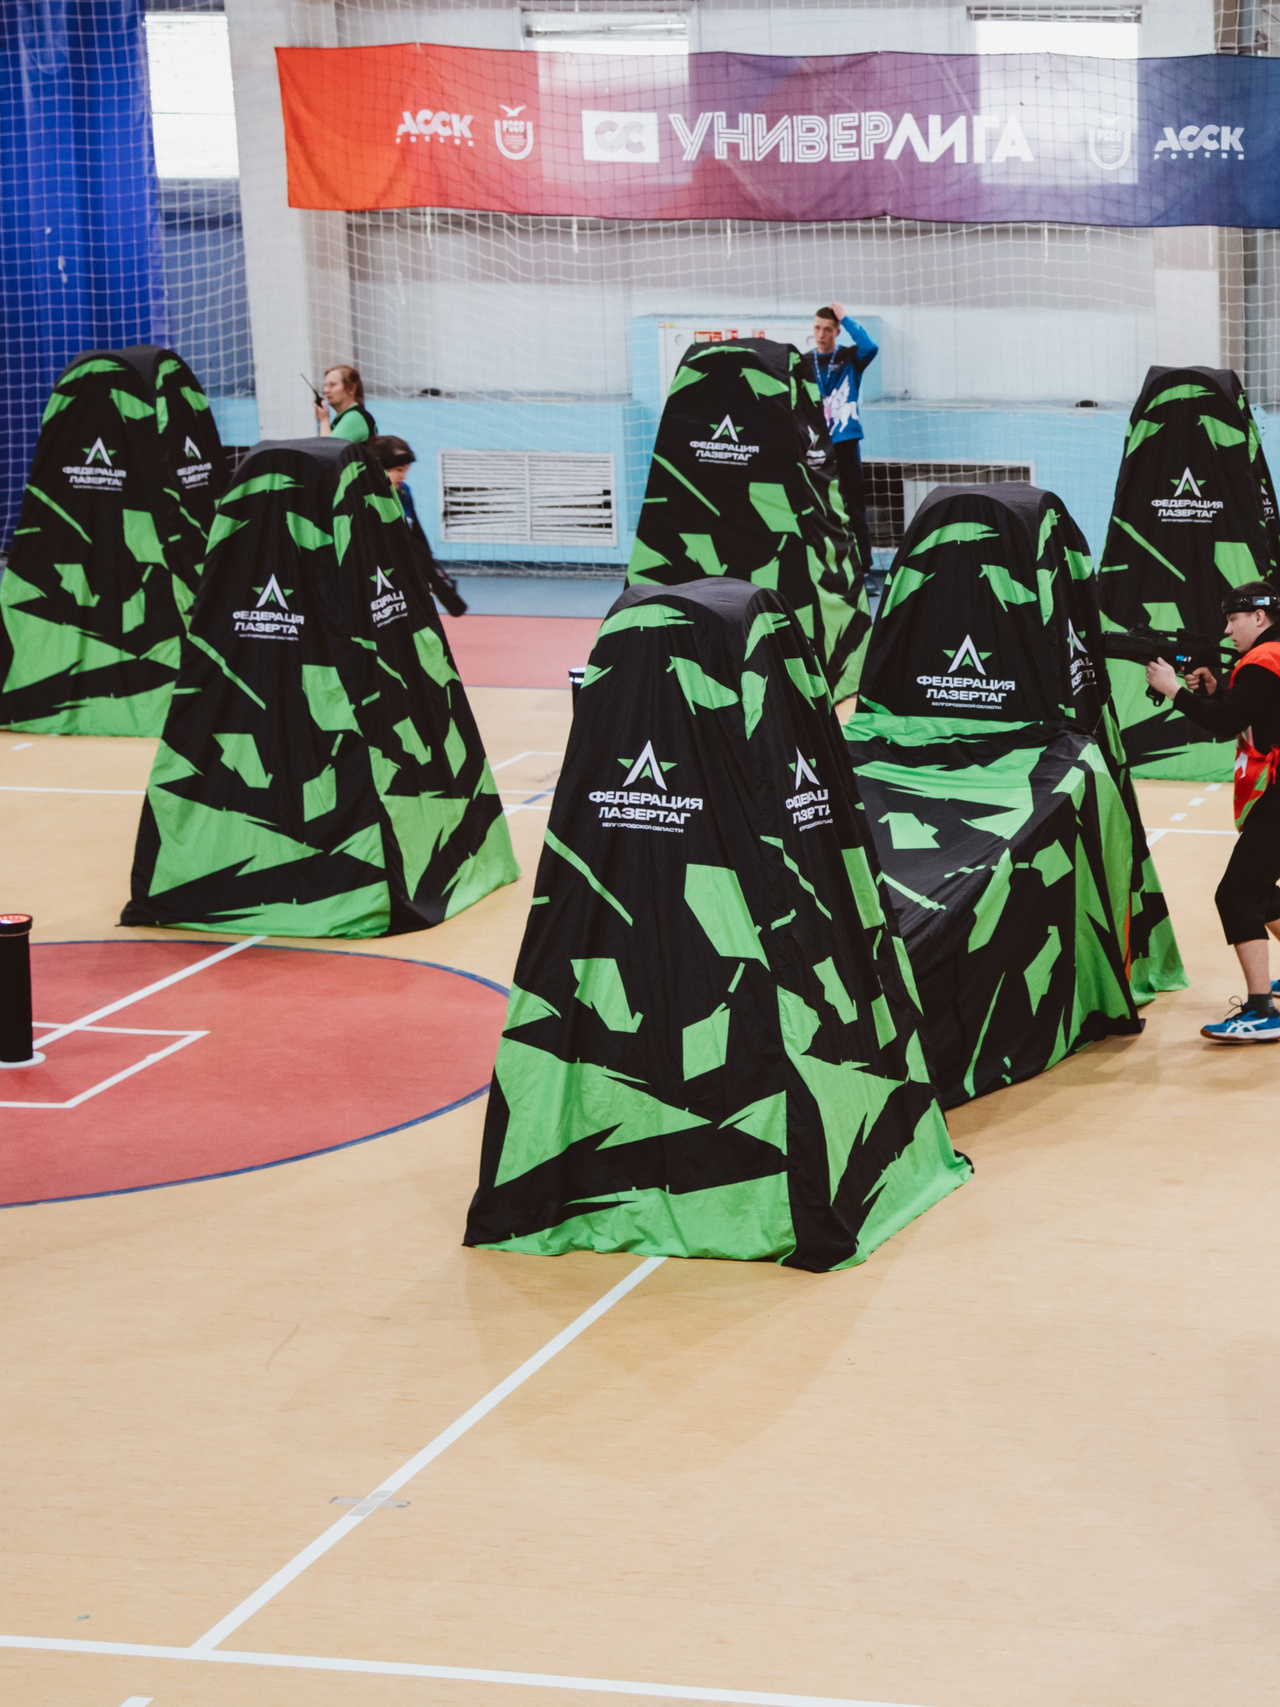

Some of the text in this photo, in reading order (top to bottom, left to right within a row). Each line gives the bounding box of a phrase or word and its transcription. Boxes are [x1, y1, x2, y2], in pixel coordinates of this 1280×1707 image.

[667, 111, 1035, 163] УНИВЕРЛИГА
[689, 440, 760, 454] ФЕДЕРАЦИЯ
[695, 449, 752, 461] ЛАЗЕРТАГ
[1151, 498, 1224, 509] ФЕДЕРАЦИЯ
[1157, 508, 1217, 518] ЛАЗЕРТАГ
[234, 621, 299, 635] ЛАЗЕРТА
[916, 675, 1015, 691] ФЕДЕРАЦИЯ
[926, 688, 1007, 703] ЛАЗЕРТАГ
[588, 790, 703, 811] ФЕДЕРАЦИЯ
[599, 806, 691, 825] ЛАЗЕРТАГ
